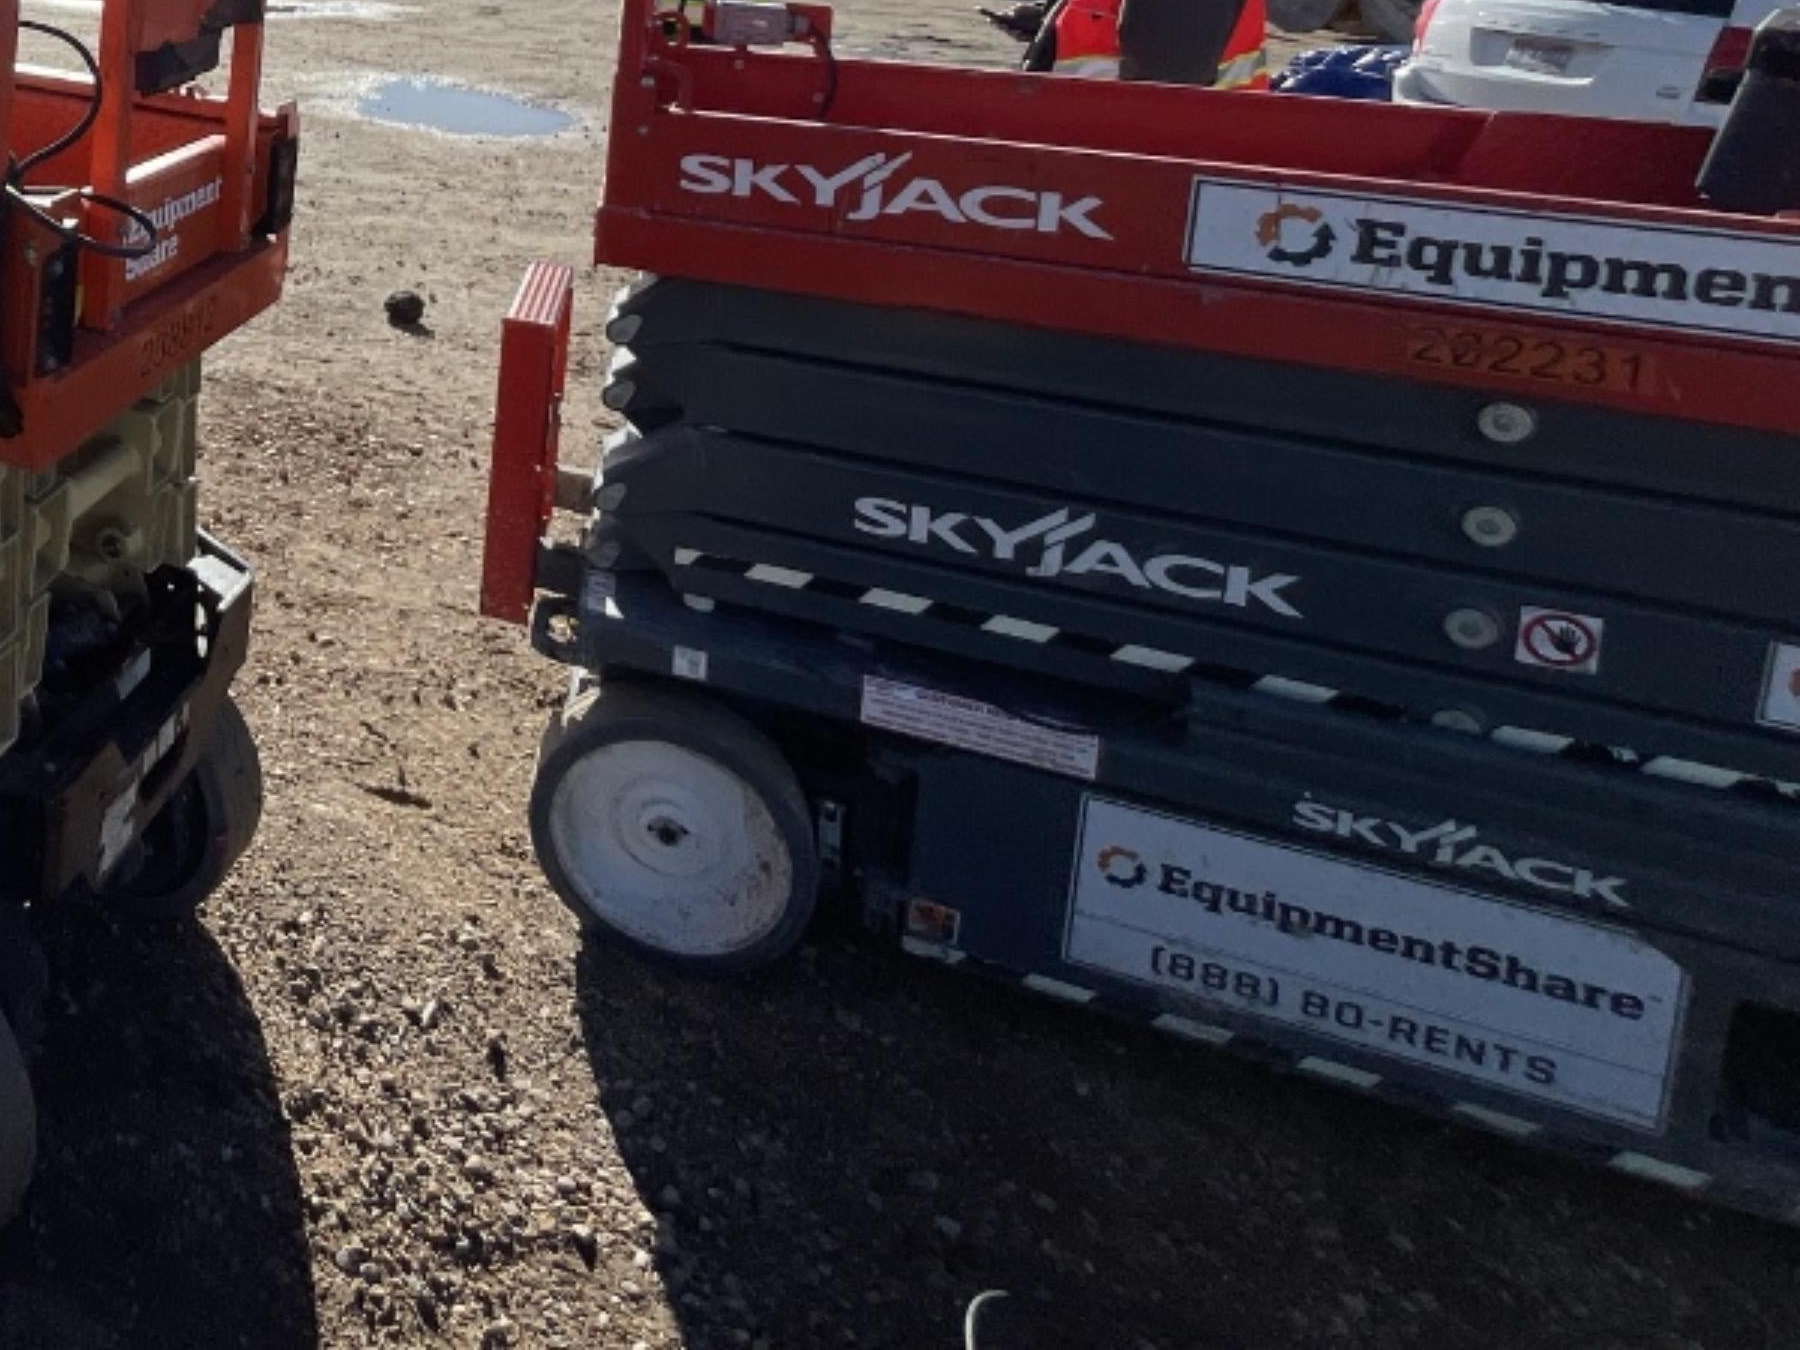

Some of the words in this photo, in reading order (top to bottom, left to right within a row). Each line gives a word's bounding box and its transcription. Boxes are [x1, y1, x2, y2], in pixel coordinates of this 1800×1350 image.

[679, 150, 1115, 241] SKYJACK
[853, 496, 1304, 618] SKYJACK
[1291, 799, 1630, 907] SKYJACK
[1156, 863, 1647, 1021] EquipmentShare
[1150, 945, 1280, 1006] (888)
[1300, 987, 1558, 1086] 80-RENTS
